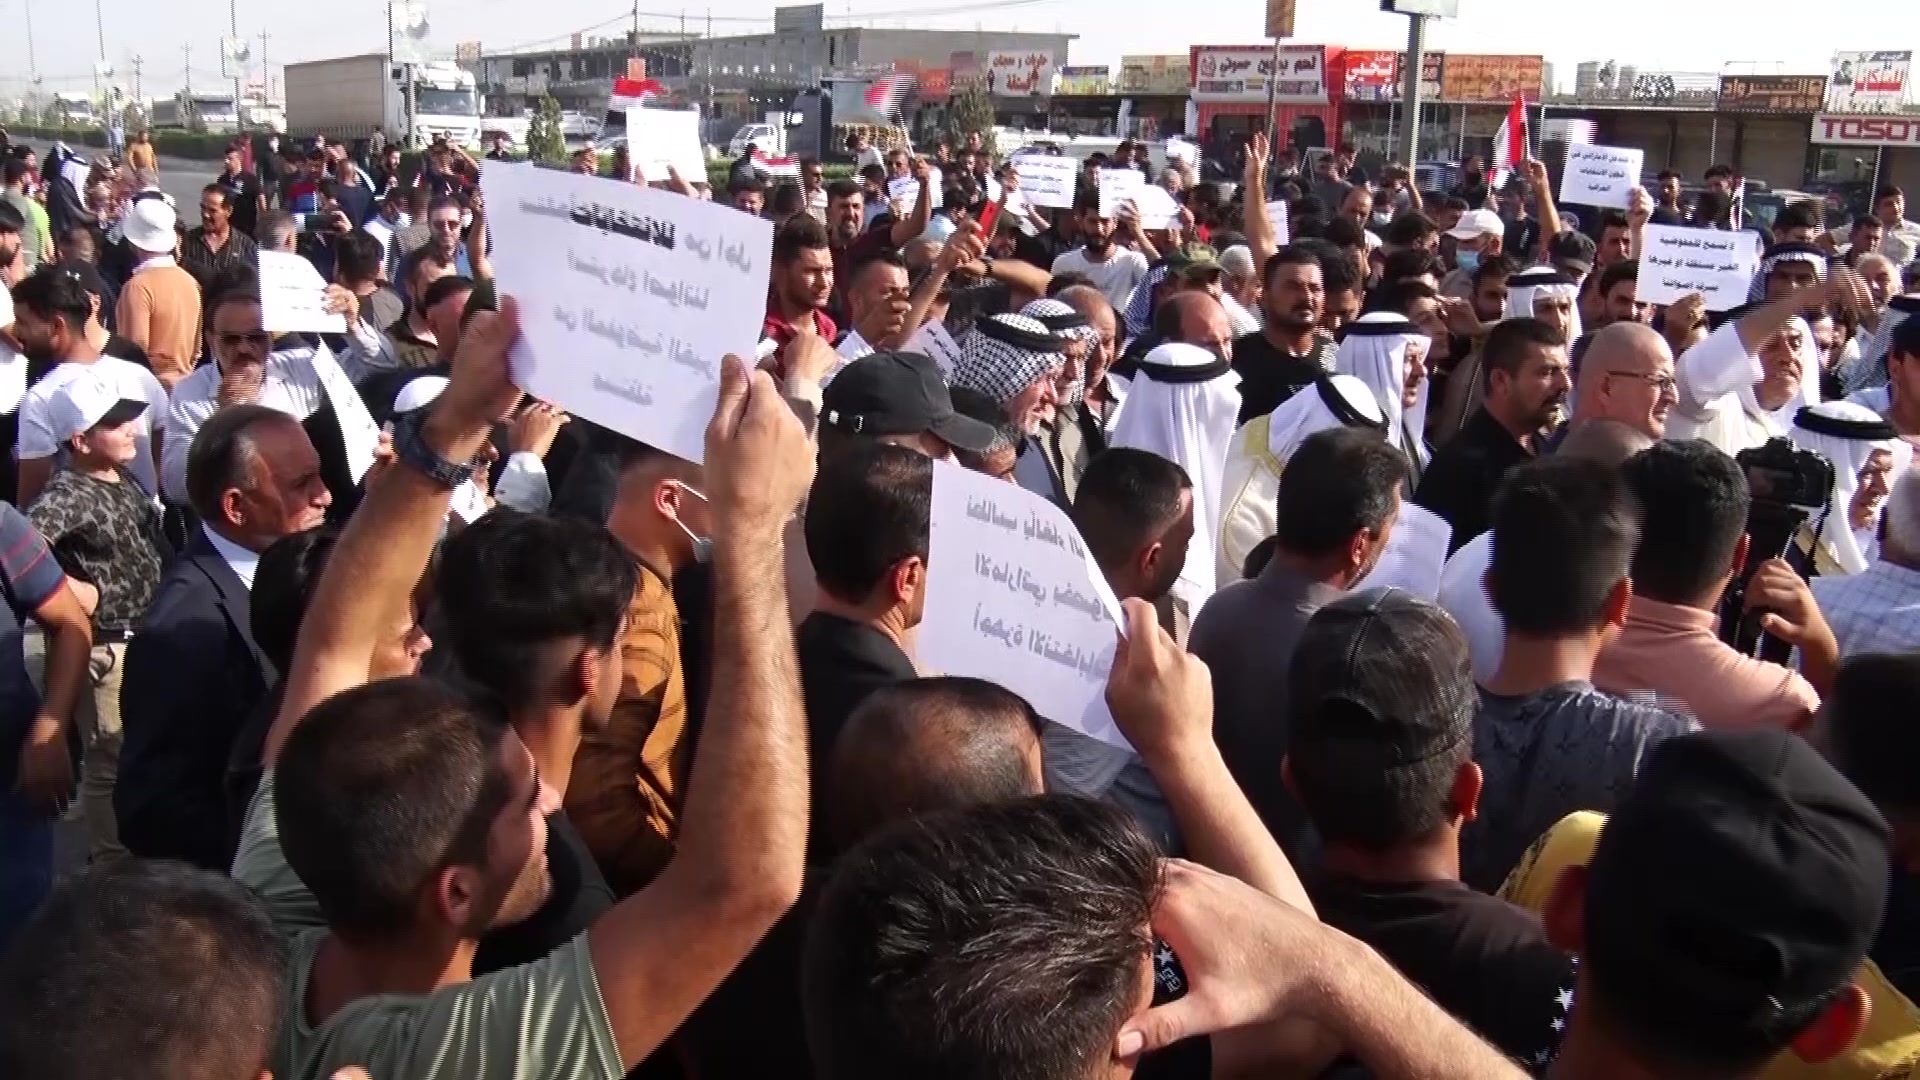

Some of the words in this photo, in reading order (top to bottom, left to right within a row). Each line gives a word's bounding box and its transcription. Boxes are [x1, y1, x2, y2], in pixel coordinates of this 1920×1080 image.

[1294, 54, 1317, 75] لحم
[1729, 240, 1736, 252] لا
[1648, 254, 1673, 266] غيرها
[1717, 262, 1740, 274] الغير
[1661, 277, 1694, 291] اصواتنا
